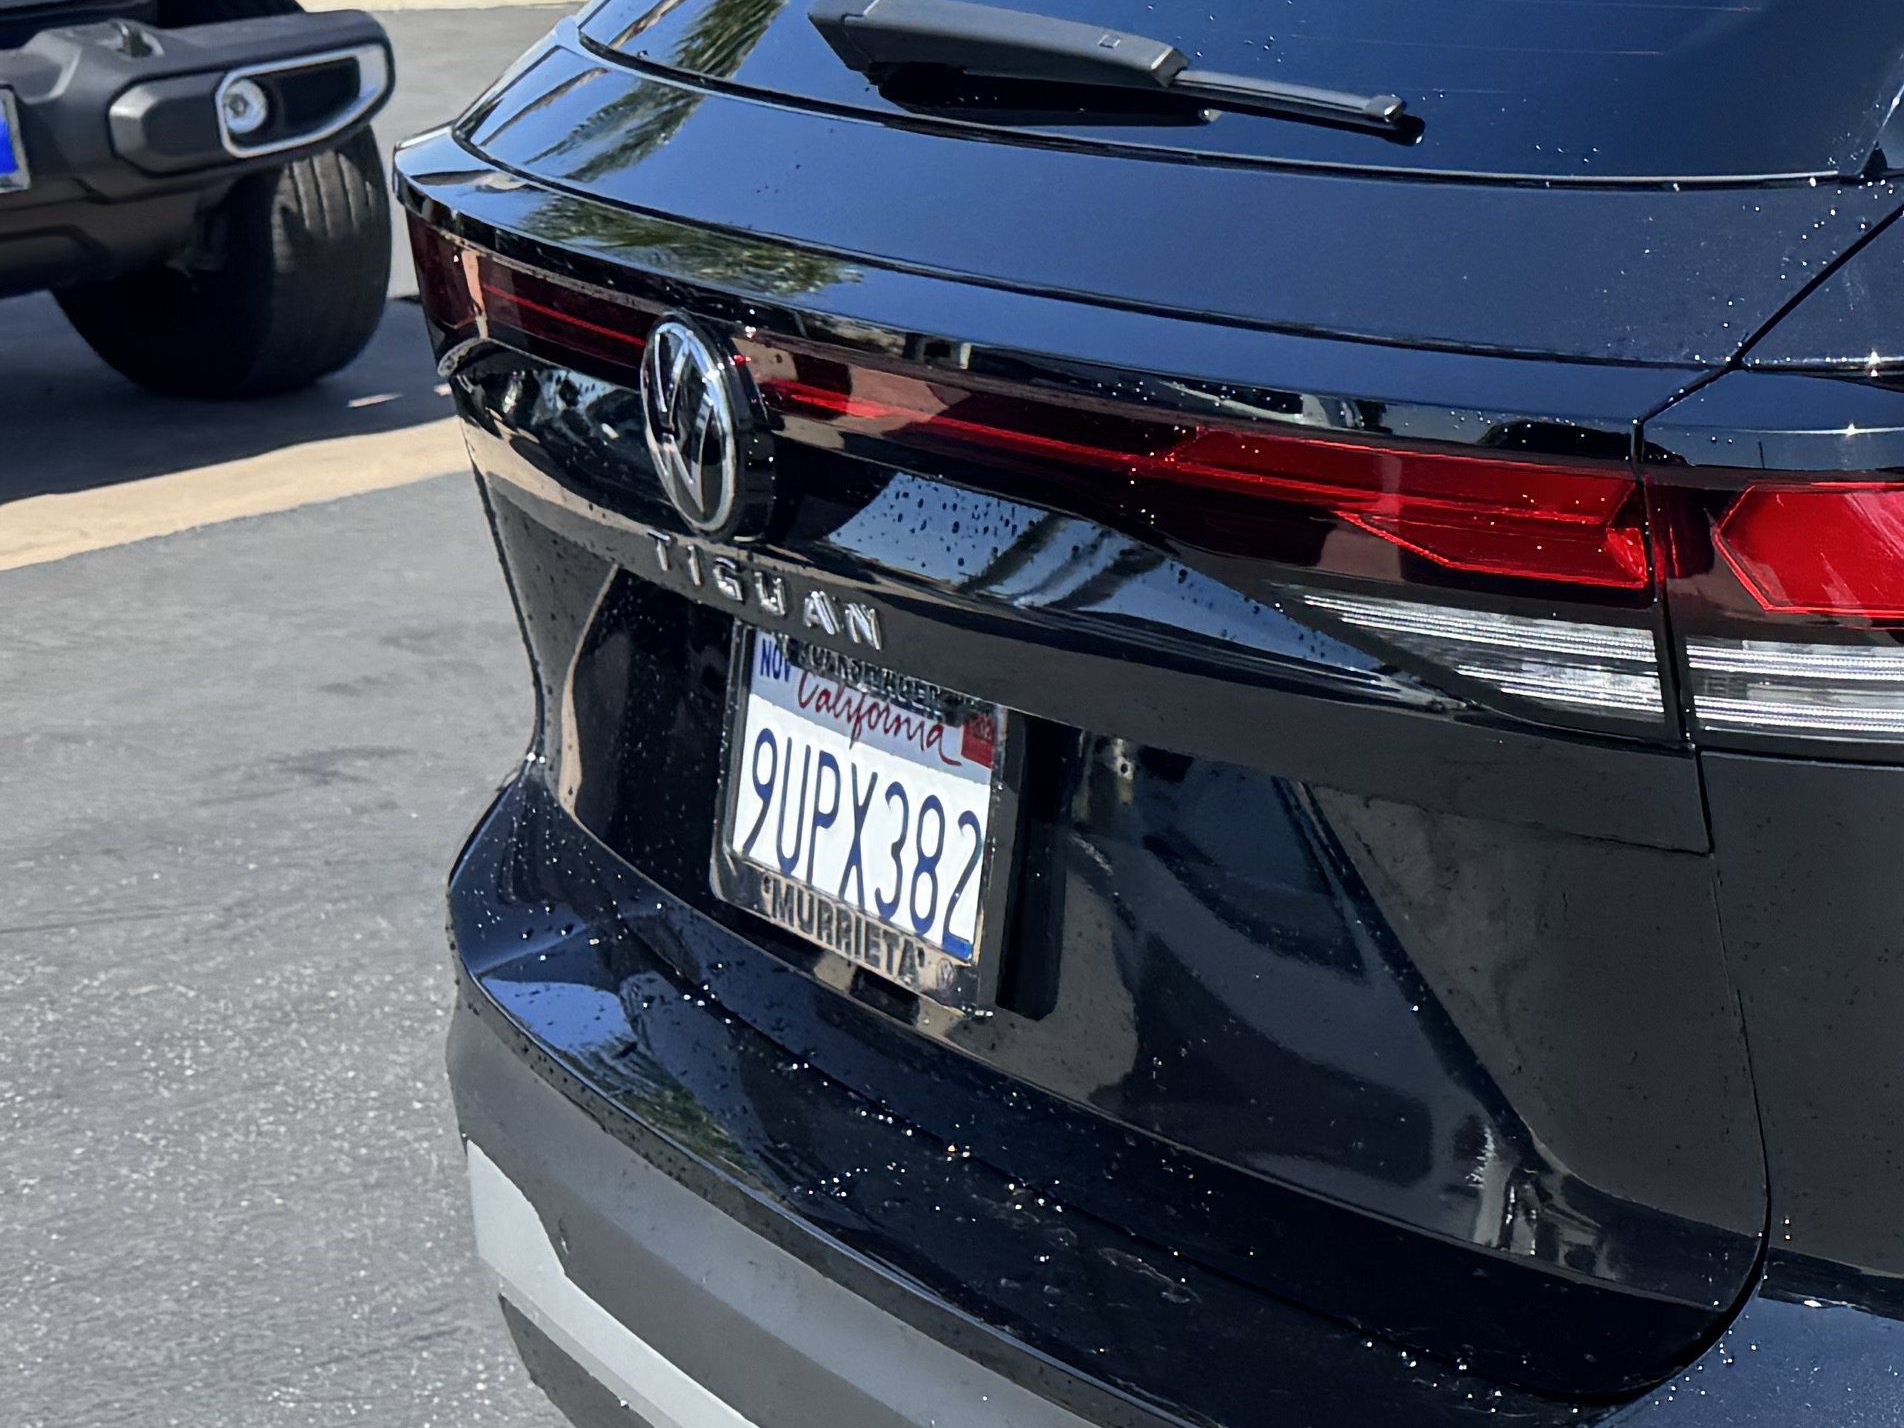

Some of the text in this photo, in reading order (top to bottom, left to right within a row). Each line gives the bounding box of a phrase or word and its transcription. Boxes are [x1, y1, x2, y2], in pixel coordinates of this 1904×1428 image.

[647, 528, 881, 651] TIGUAN
[760, 637, 792, 683] NOV
[797, 668, 962, 767] California
[742, 727, 983, 961] 9UPX382
[770, 873, 922, 994] MURRIETA
